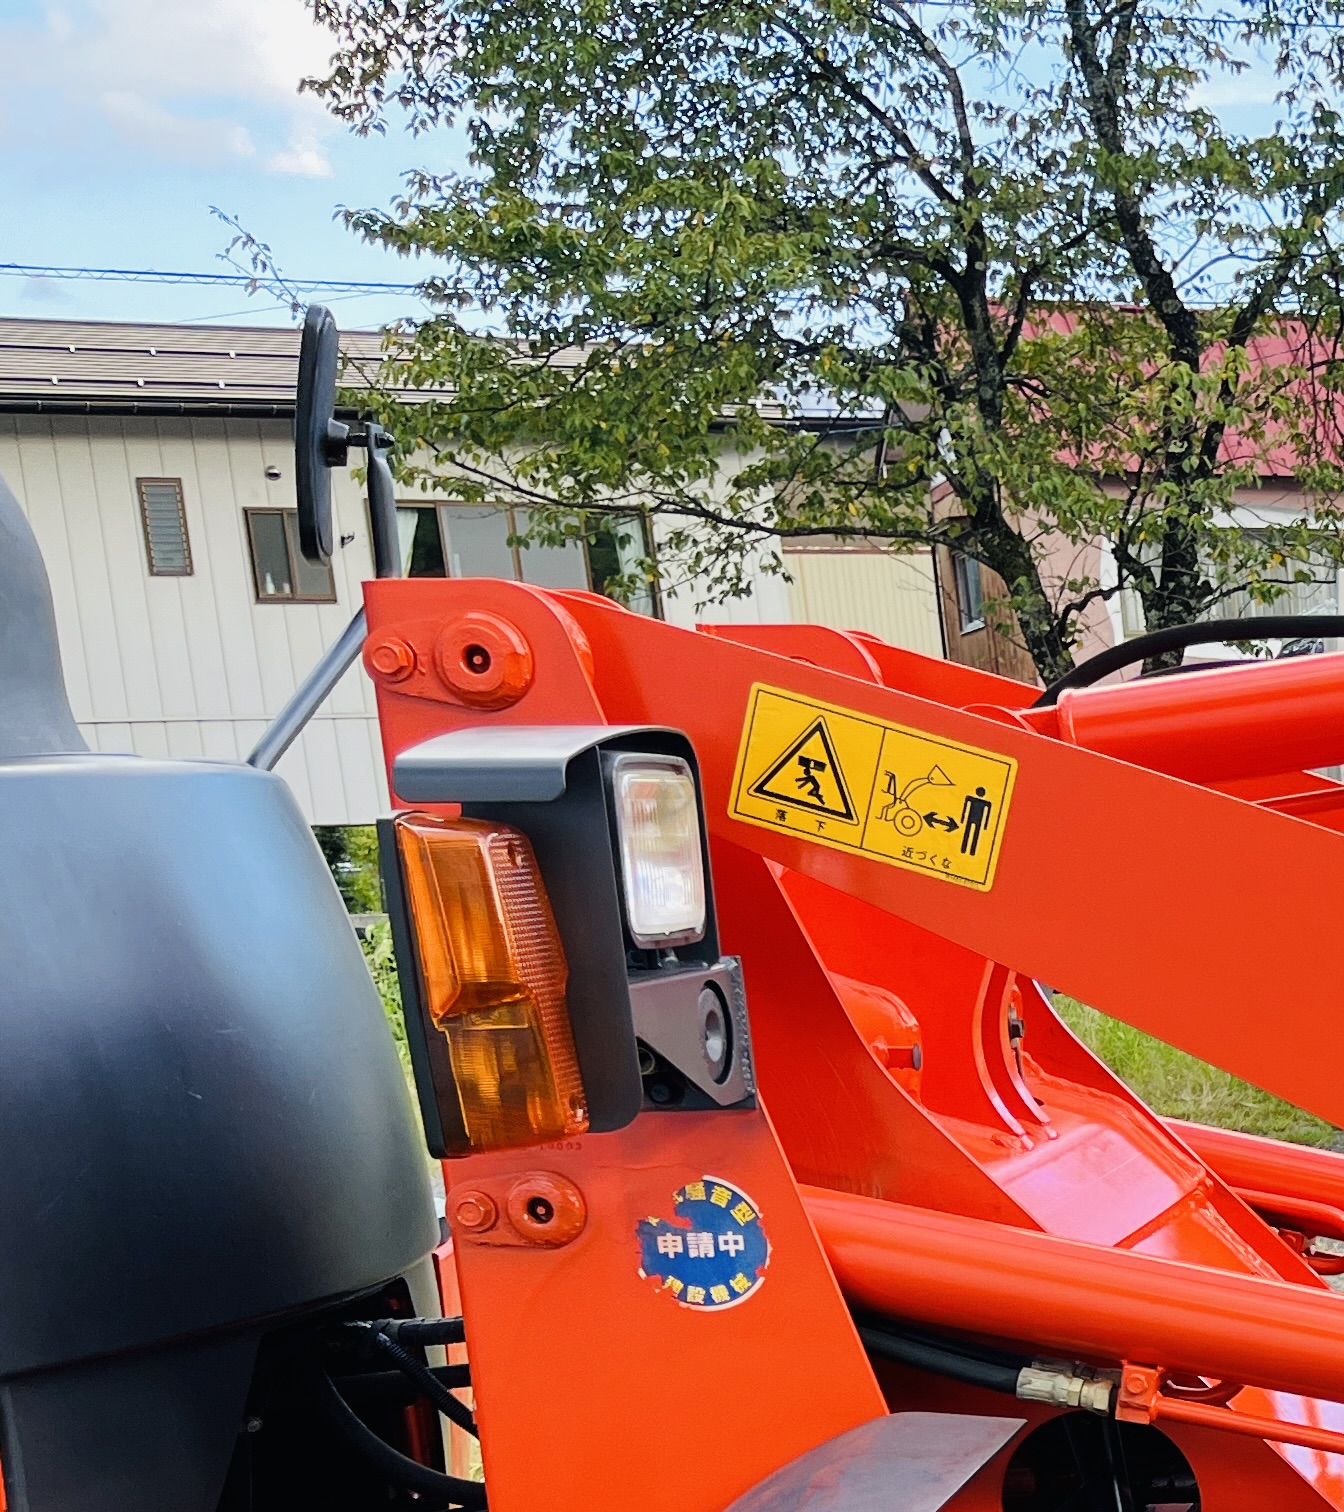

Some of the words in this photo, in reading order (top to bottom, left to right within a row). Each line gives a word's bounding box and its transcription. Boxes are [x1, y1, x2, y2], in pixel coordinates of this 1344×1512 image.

[901, 846, 952, 869] 近づくな
[656, 1231, 746, 1259] 申請中
